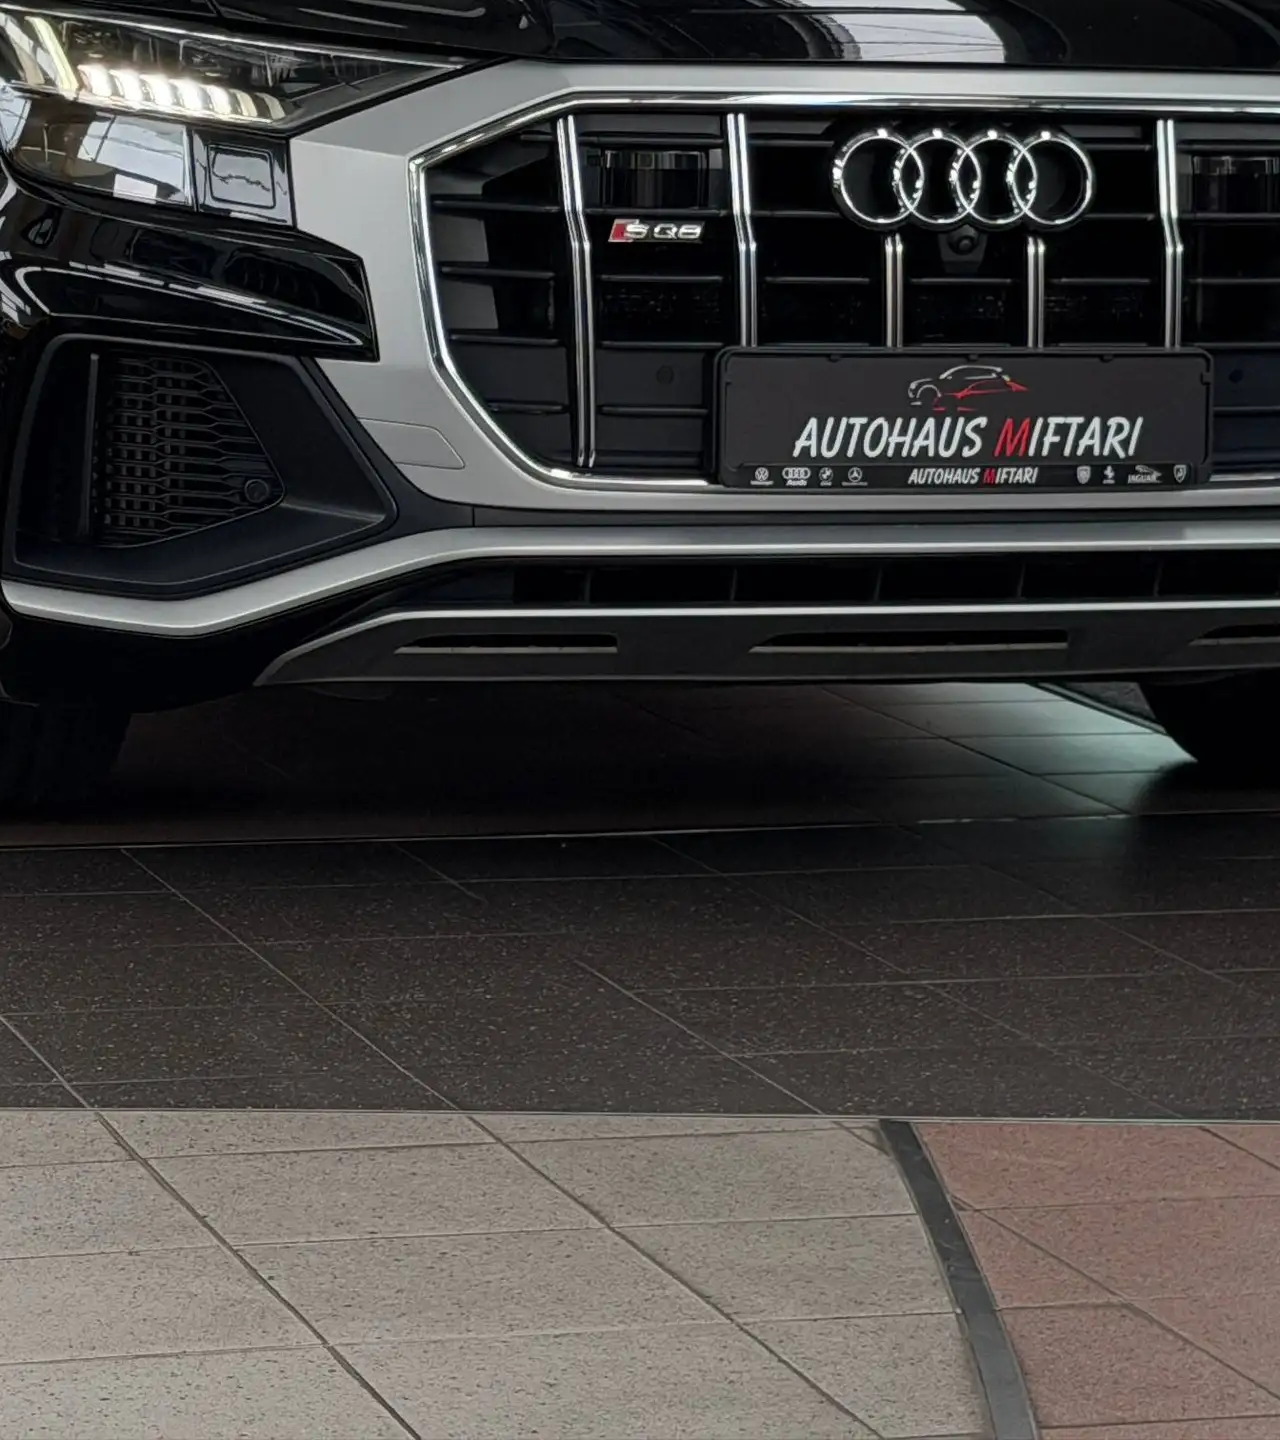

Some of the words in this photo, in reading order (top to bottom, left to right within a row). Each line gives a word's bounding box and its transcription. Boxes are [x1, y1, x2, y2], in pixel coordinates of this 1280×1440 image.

[624, 222, 702, 239] SQ8
[792, 416, 988, 459] AUTOHAUS
[994, 416, 1144, 460] MIFTARI
[907, 467, 981, 486] AUTOHAUS
[983, 466, 1040, 485] MIFTARI
